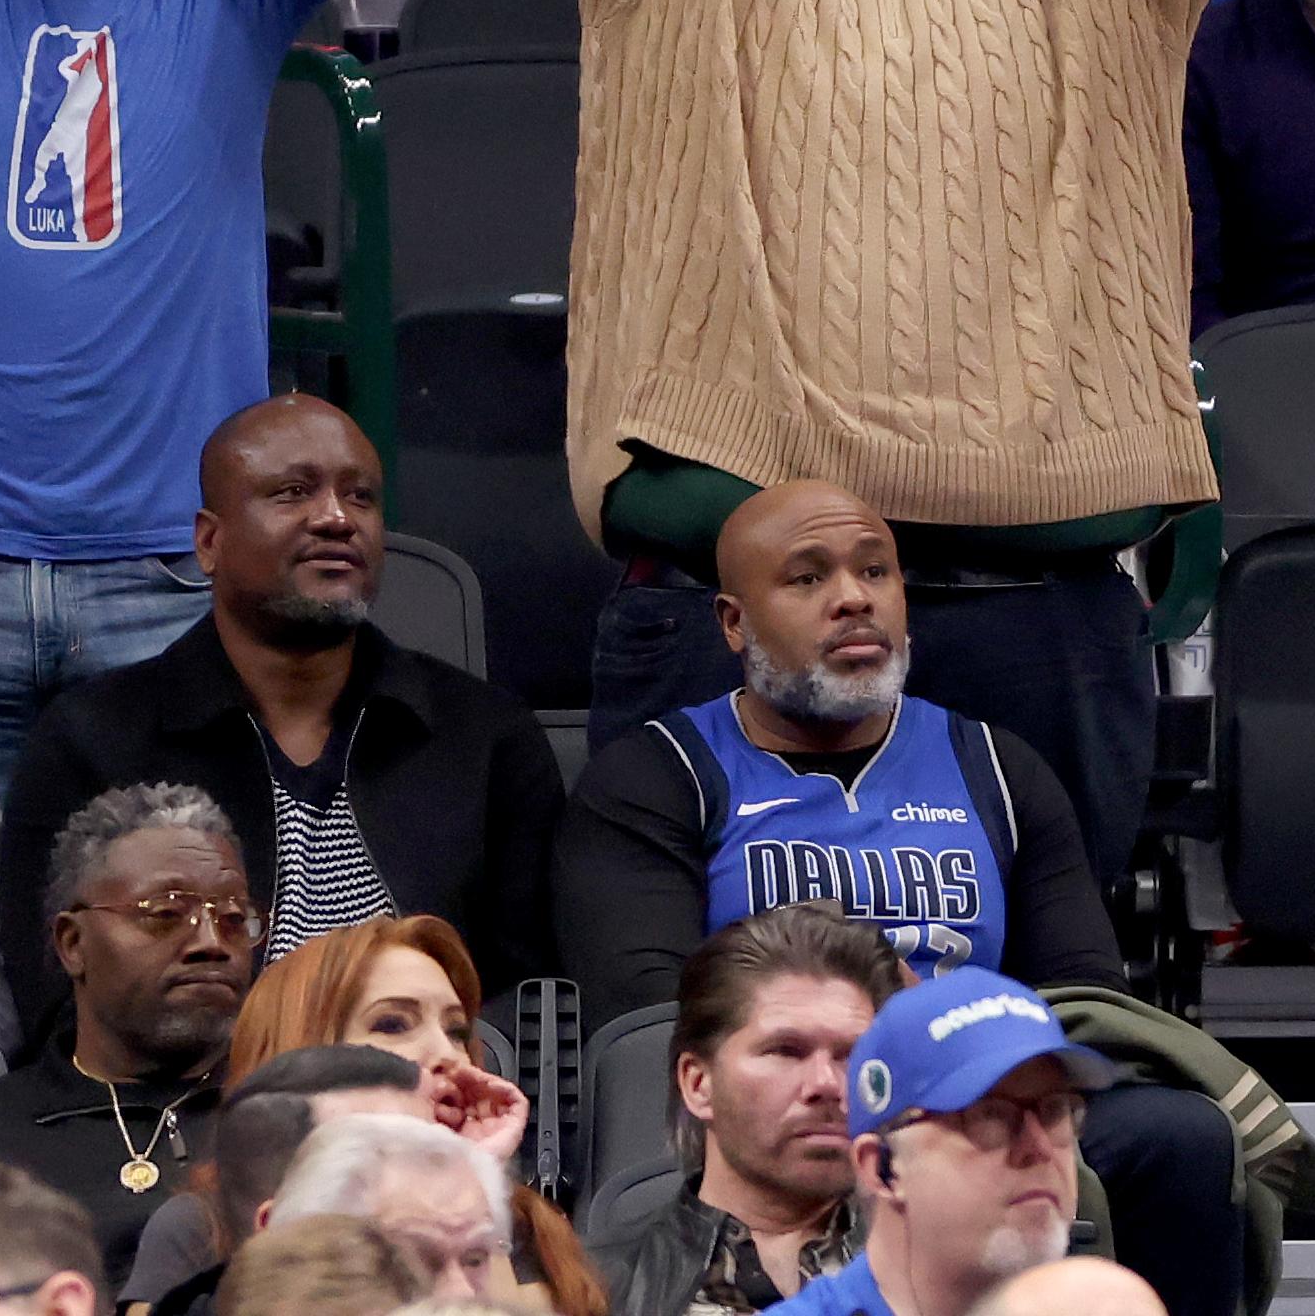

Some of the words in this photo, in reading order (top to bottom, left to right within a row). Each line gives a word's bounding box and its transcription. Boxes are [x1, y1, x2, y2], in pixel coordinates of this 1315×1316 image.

[28, 207, 66, 232] LUKA
[891, 802, 968, 824] chime
[744, 839, 981, 923] DALLAS
